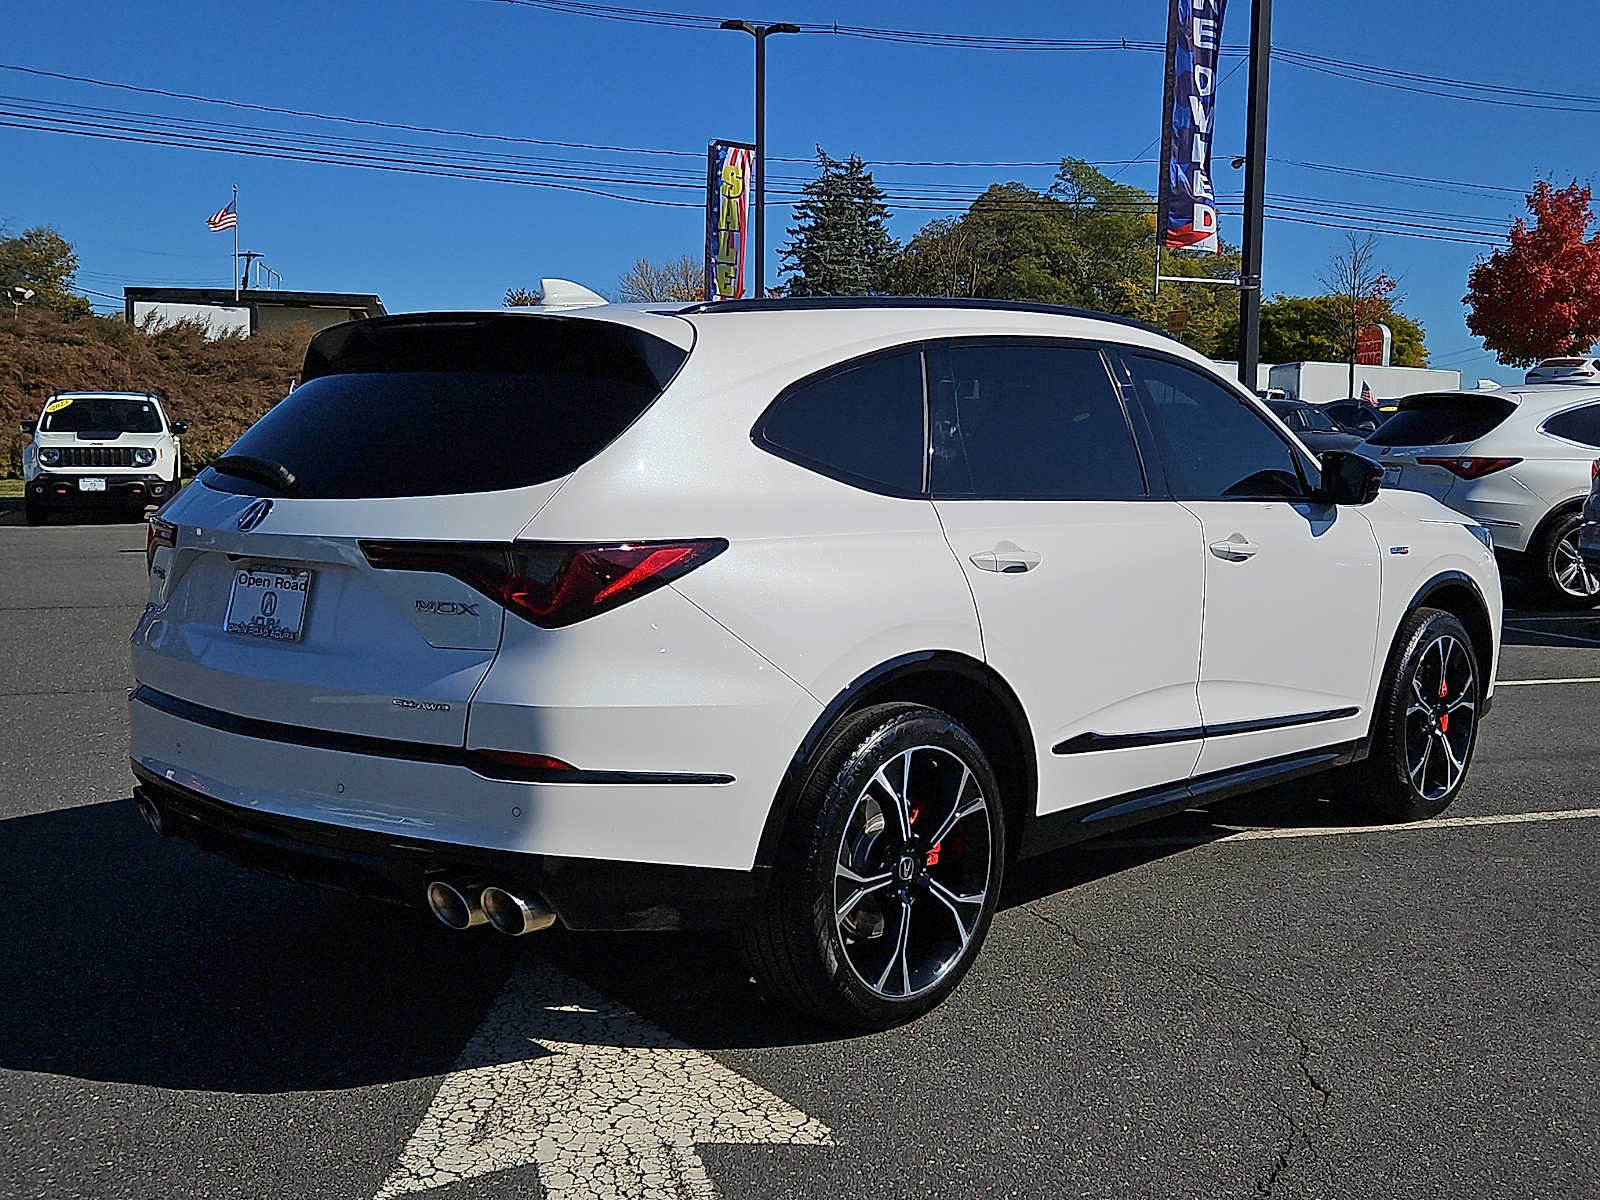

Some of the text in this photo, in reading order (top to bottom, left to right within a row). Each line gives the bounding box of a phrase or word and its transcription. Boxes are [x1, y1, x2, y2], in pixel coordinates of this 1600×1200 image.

[717, 164, 743, 298] SALE
[239, 574, 306, 591] Open Road
[416, 600, 479, 616] MDX
